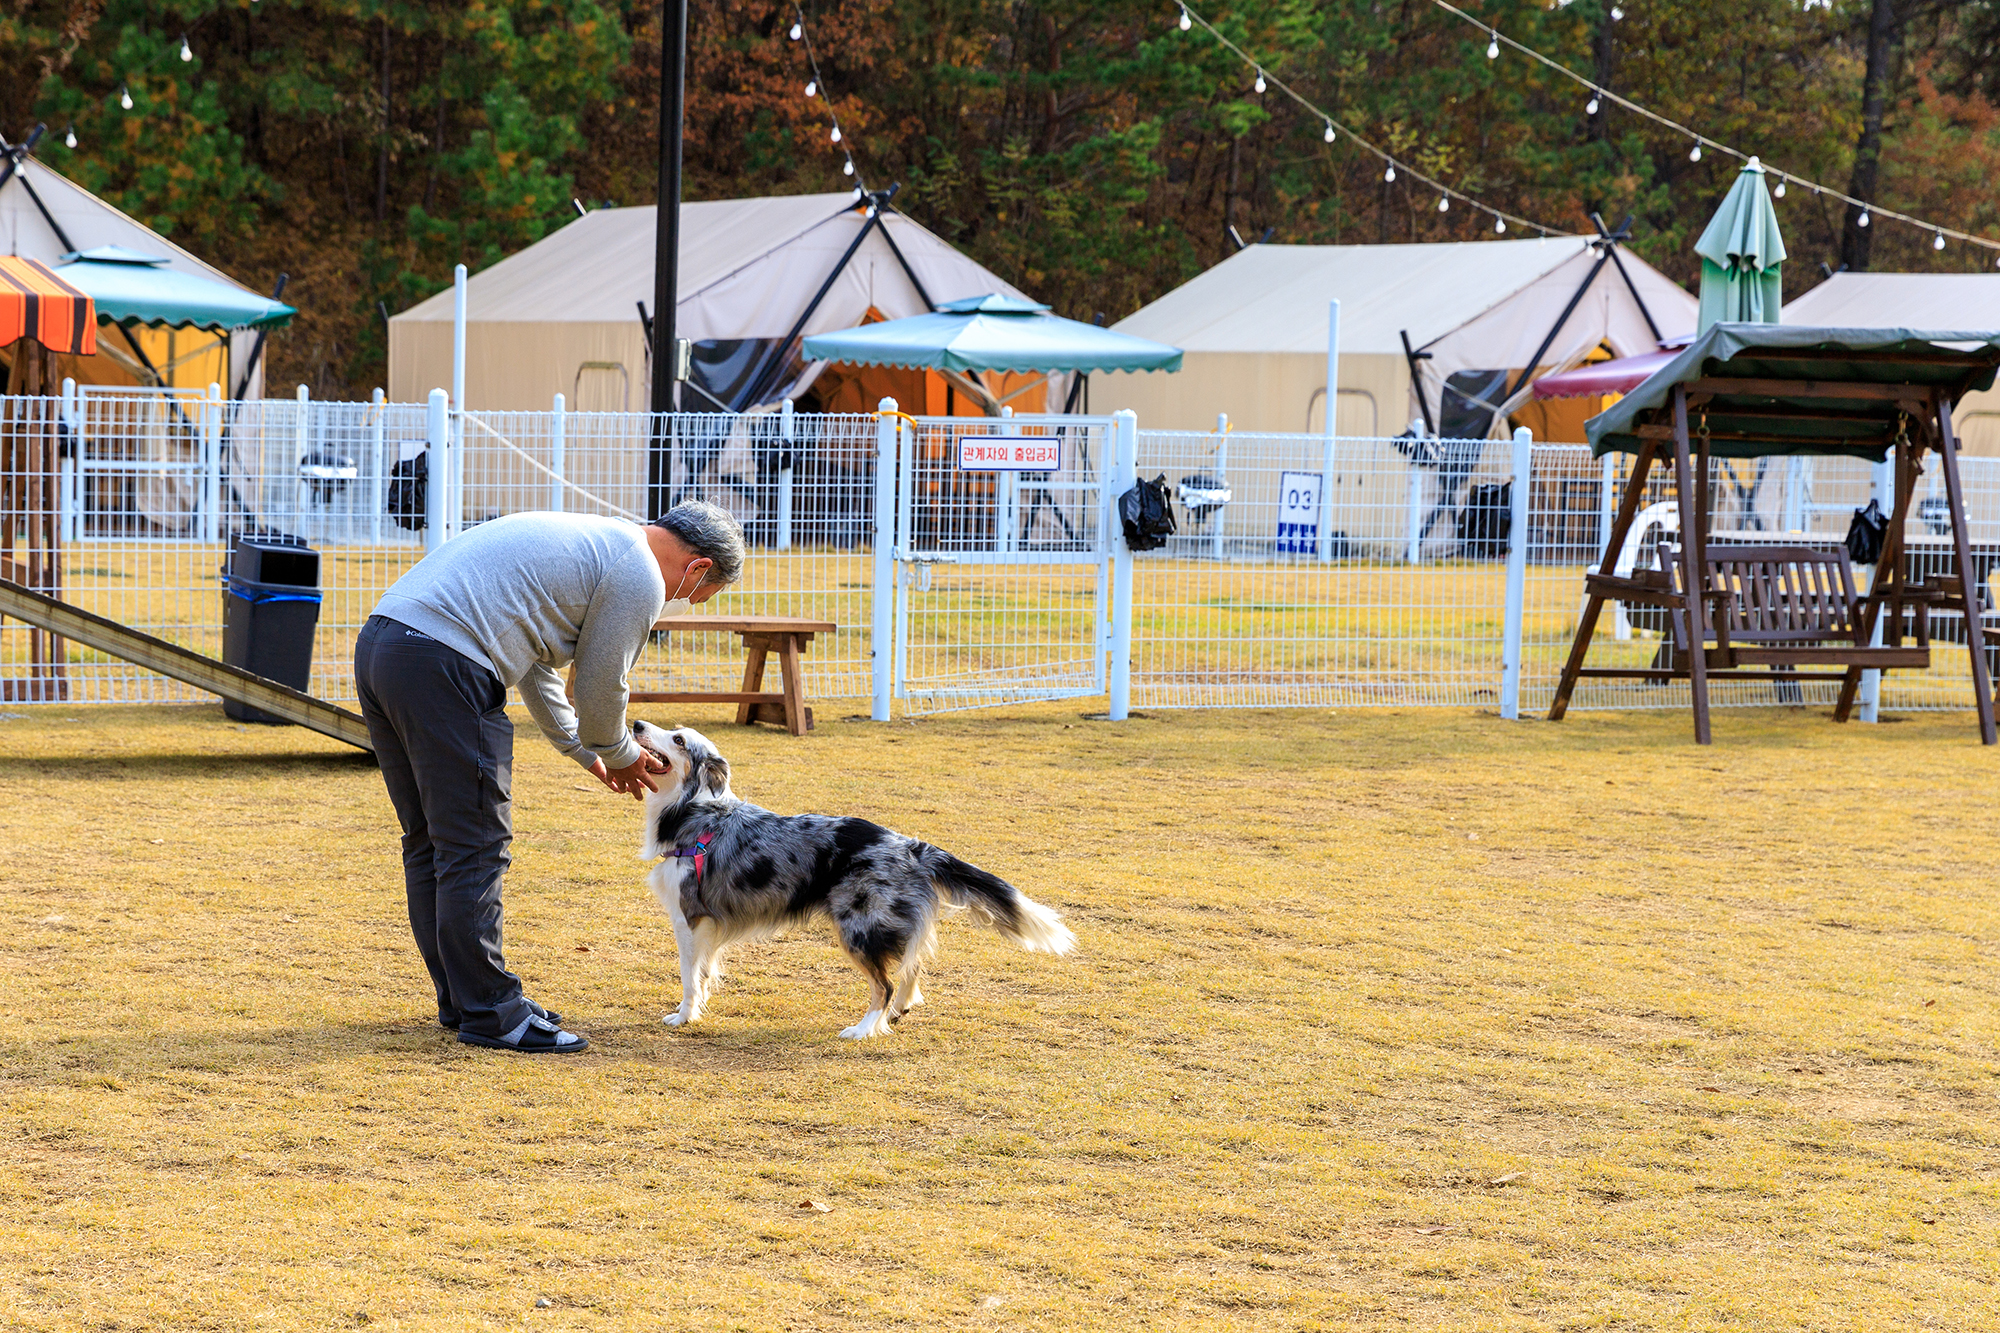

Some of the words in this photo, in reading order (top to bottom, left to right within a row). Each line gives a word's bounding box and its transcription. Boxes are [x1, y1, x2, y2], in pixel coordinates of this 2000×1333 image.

[963, 447, 1008, 462] 관계자외
[1014, 447, 1057, 462] 출입금지
[1288, 489, 1312, 511] 03
